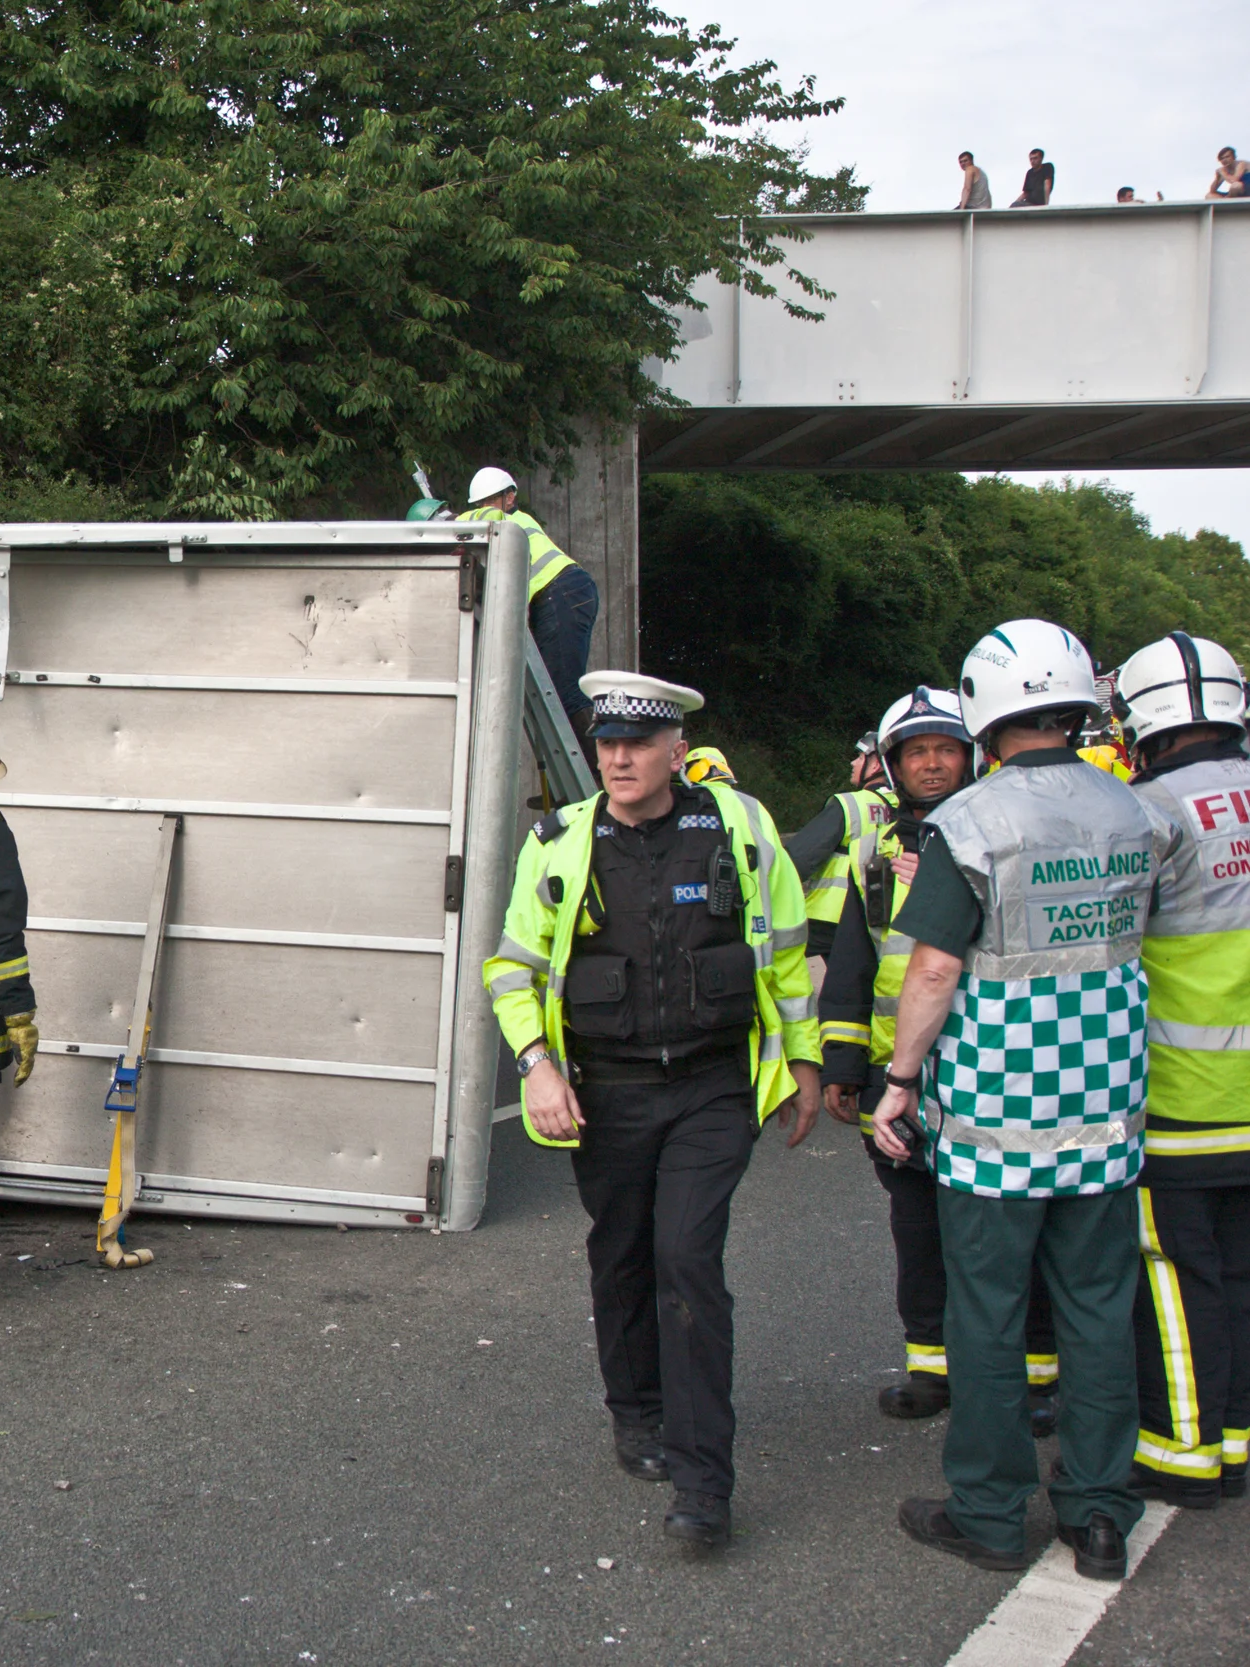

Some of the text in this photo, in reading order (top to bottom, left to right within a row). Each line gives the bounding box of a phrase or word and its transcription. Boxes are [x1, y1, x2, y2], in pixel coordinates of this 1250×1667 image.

[1193, 789, 1250, 832] FI
[1031, 851, 1150, 885] AMBULANCE
[1042, 896, 1139, 922] TACTICAL
[1048, 915, 1135, 943] ADVISOR
